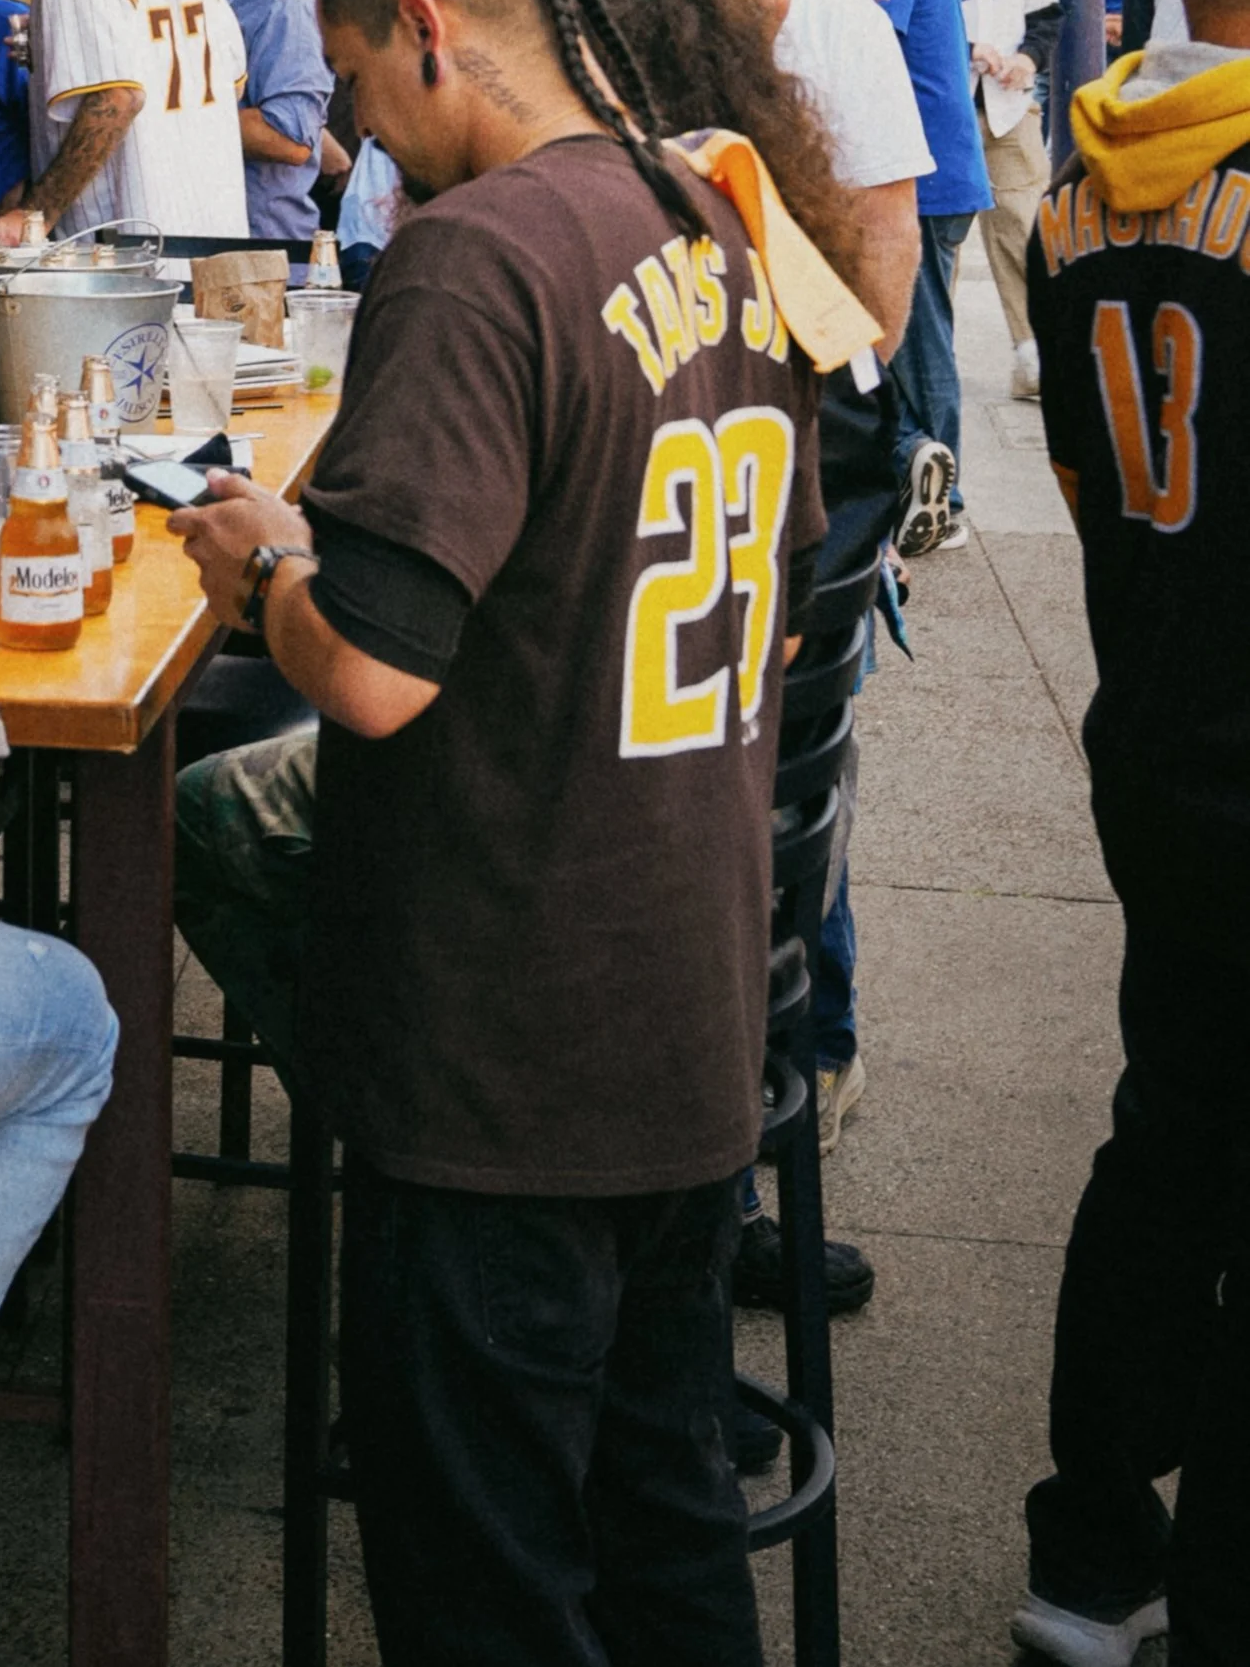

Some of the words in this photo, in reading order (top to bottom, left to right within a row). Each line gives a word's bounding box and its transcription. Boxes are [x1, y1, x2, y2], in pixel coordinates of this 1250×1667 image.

[146, 0, 216, 115] 77
[1090, 300, 1203, 534] 13
[618, 406, 796, 760] 23
